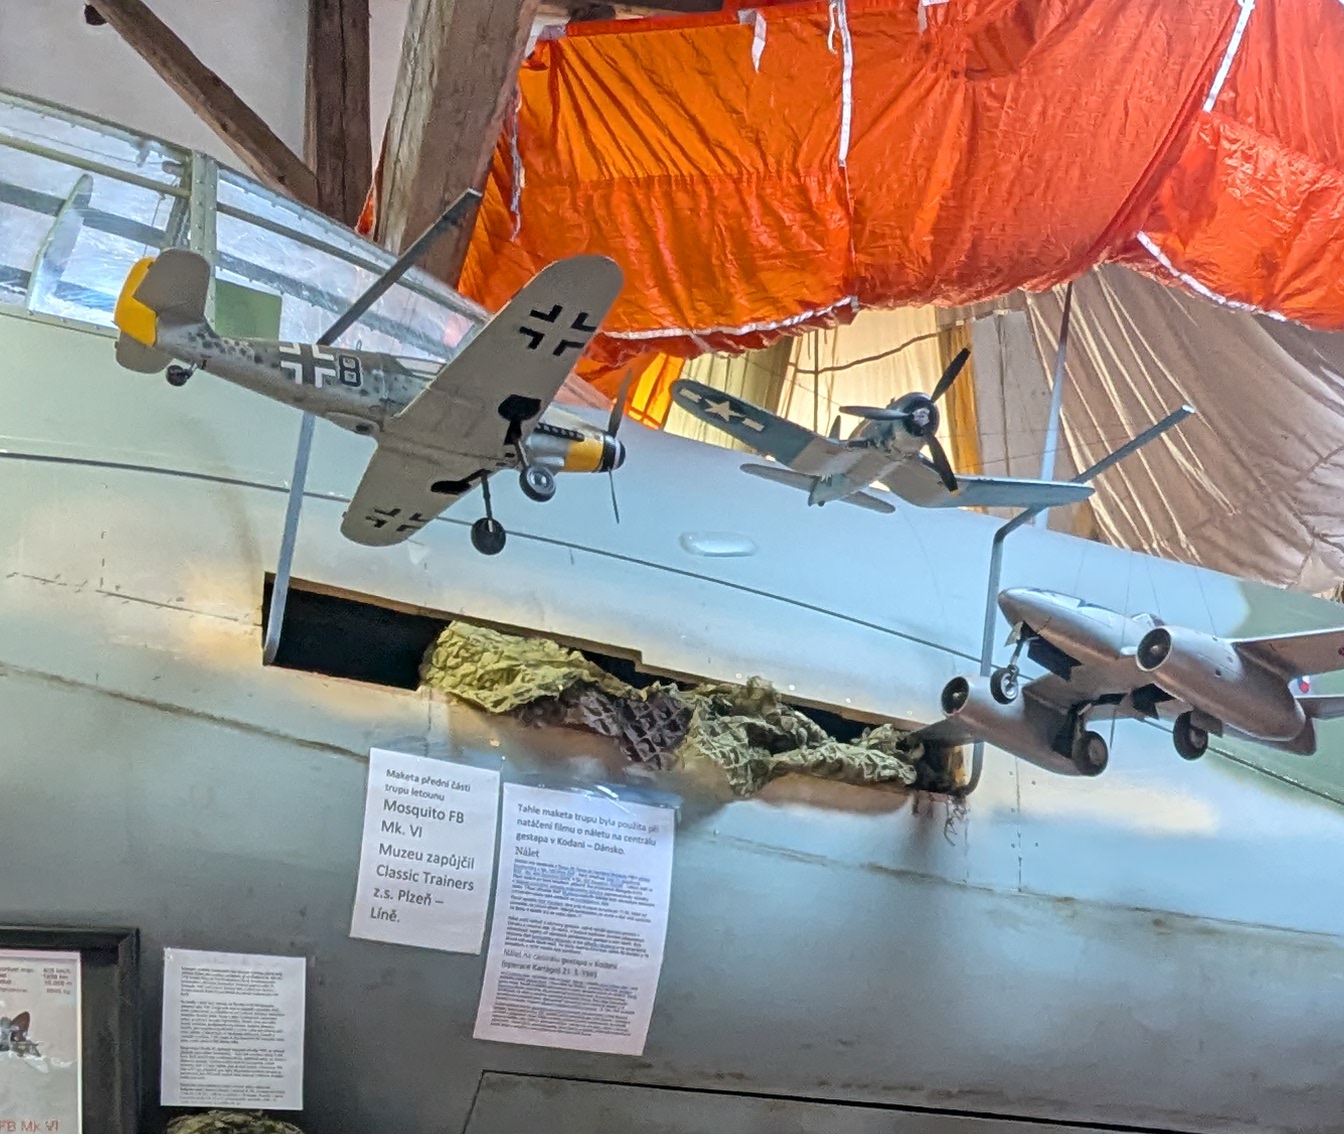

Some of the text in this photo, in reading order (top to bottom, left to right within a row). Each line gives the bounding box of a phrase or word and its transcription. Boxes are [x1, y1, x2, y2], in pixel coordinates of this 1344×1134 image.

[338, 354, 364, 386] 8
[386, 769, 470, 792] Maketa přední části
[385, 784, 445, 802] trupu letounu
[383, 799, 464, 823] Mosquito FB
[518, 804, 540, 814] Tahle
[542, 808, 573, 820] maketa
[575, 813, 597, 824] trupu
[381, 820, 422, 838] Mk. VI
[517, 818, 552, 829] natáčení
[554, 822, 575, 833] filmu
[585, 827, 610, 839] náletu
[624, 834, 656, 846] centrálu
[516, 832, 548, 844] gestapa
[557, 837, 585, 848] Kodani
[379, 843, 474, 870] Muzeu zapůjčil
[376, 865, 474, 891] Classic Trainers
[373, 887, 393, 900] z.s.
[398, 890, 431, 906] Plzeň
[370, 906, 400, 922] Líně.
[21, 1120, 39, 1133] Mk
